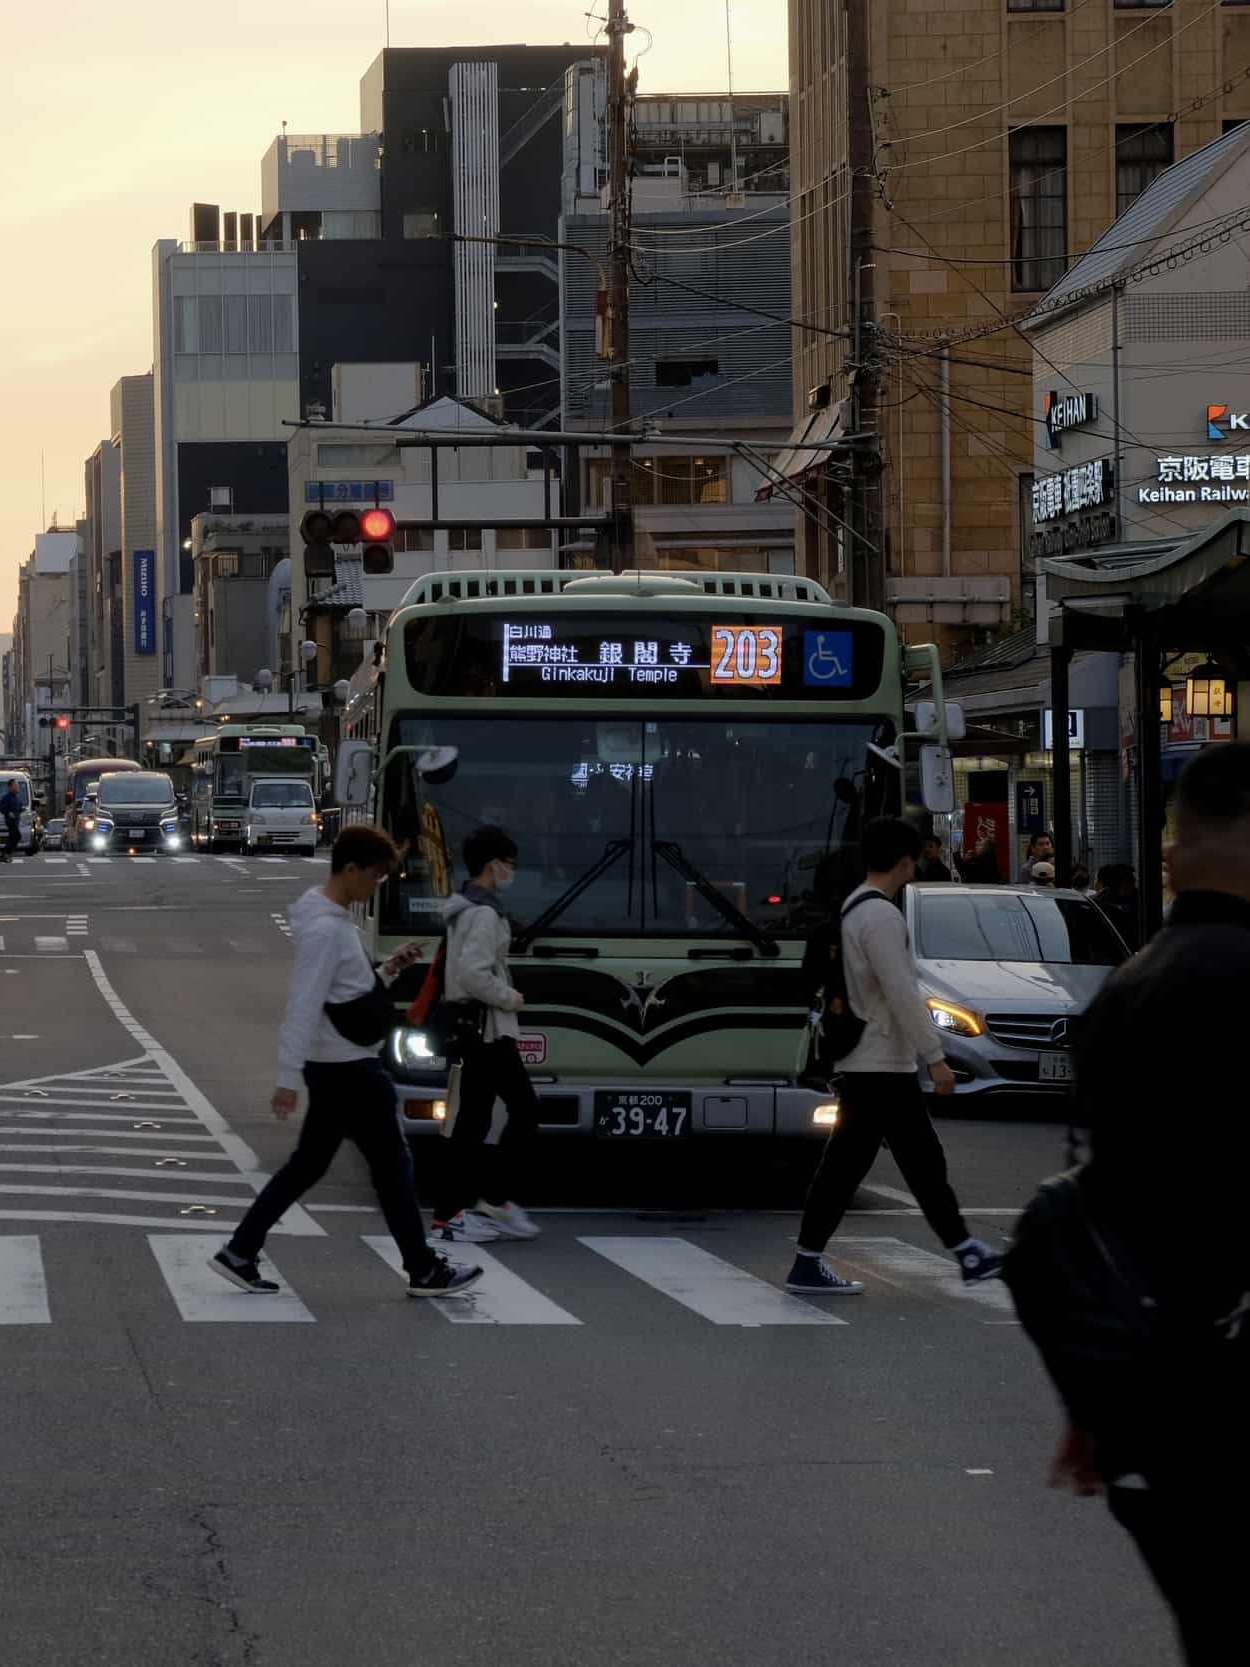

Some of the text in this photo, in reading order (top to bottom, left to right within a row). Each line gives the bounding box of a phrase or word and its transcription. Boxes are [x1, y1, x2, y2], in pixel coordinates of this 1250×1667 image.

[1051, 394, 1086, 432] KEIHAN
[1139, 486, 1195, 502] Keihan
[509, 626, 552, 639] 白川通
[509, 644, 579, 663] 熊野神社
[714, 629, 779, 678] 203
[541, 667, 678, 684] Ginkakuji Temple
[612, 1106, 687, 1136] 39-47
